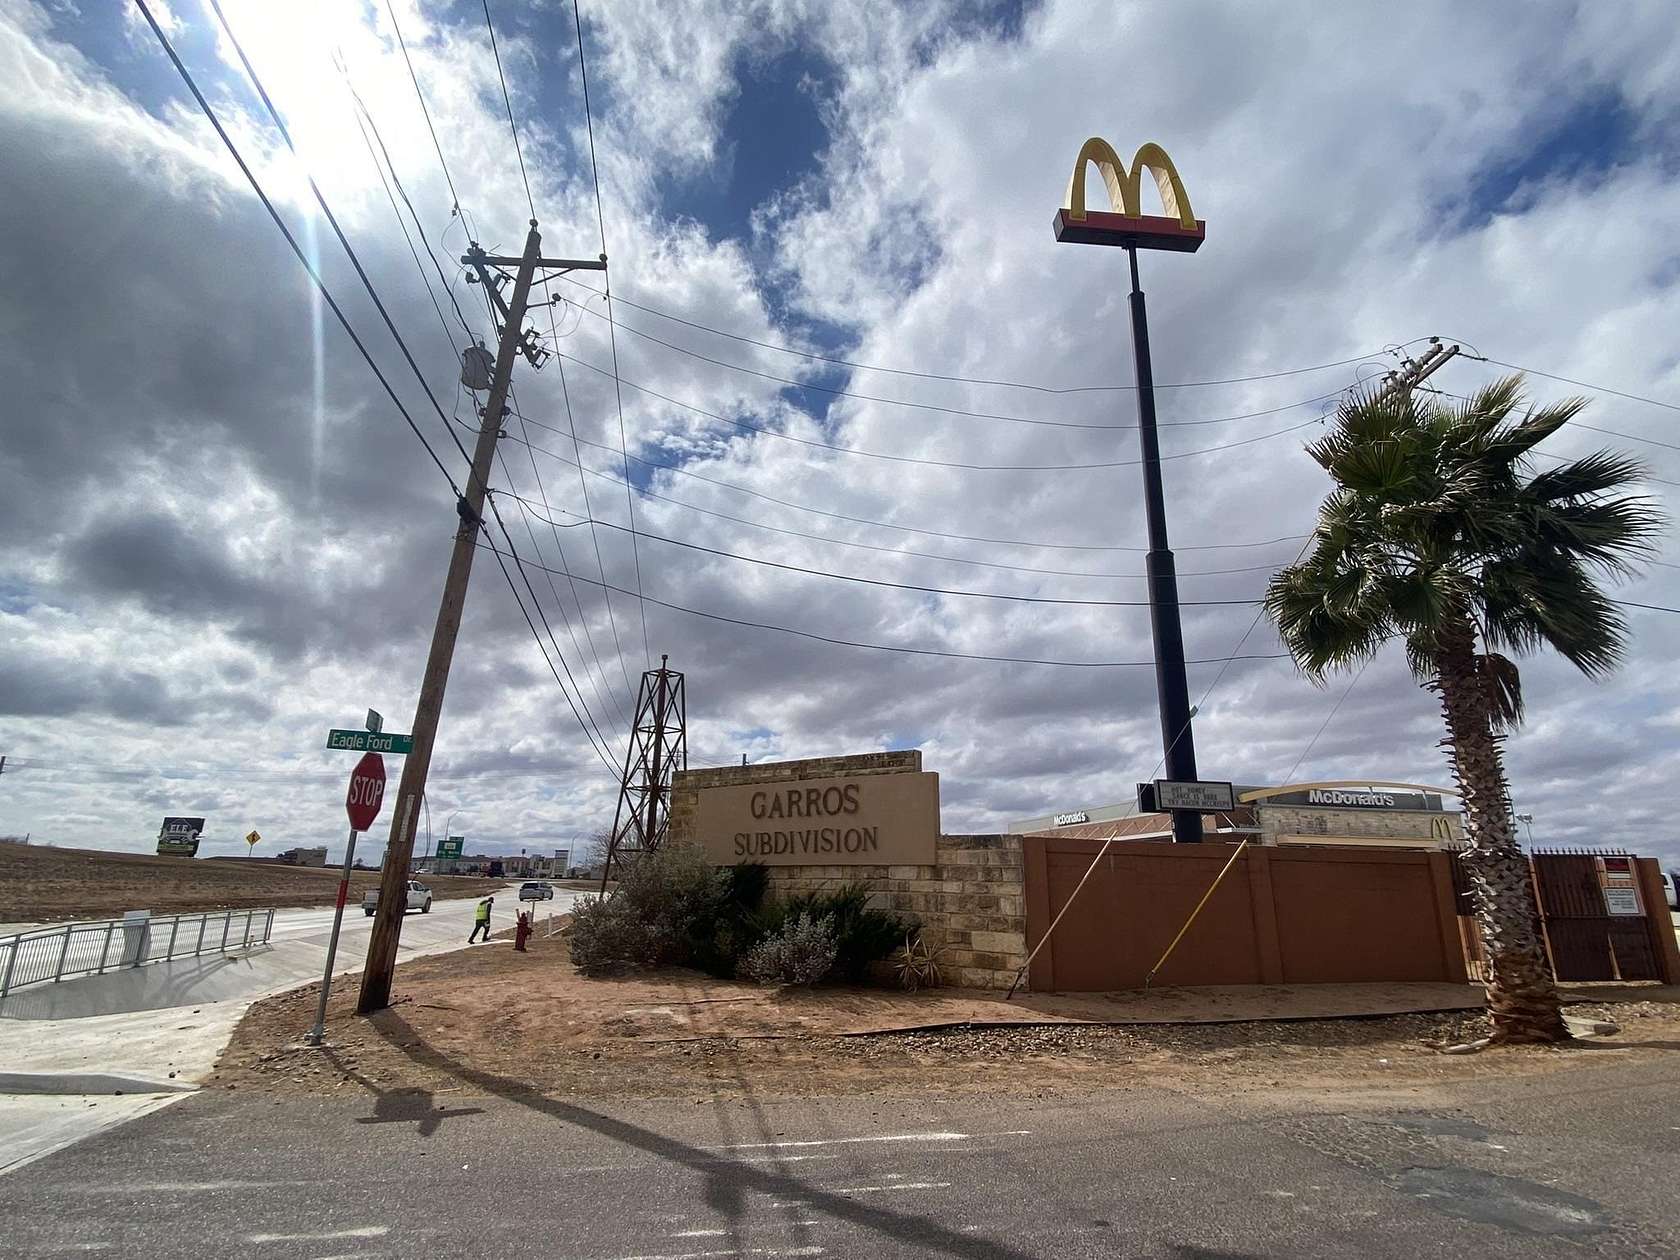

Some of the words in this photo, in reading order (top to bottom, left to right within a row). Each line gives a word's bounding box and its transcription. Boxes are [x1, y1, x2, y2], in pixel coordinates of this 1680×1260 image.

[332, 733, 363, 749] Eagle
[366, 734, 393, 750] Ford
[350, 775, 383, 806] STOP
[751, 783, 860, 819] GARROS
[1309, 789, 1395, 806] McDonald's
[1053, 811, 1087, 826] McDonald's
[734, 826, 879, 857] SUBDIVISION
